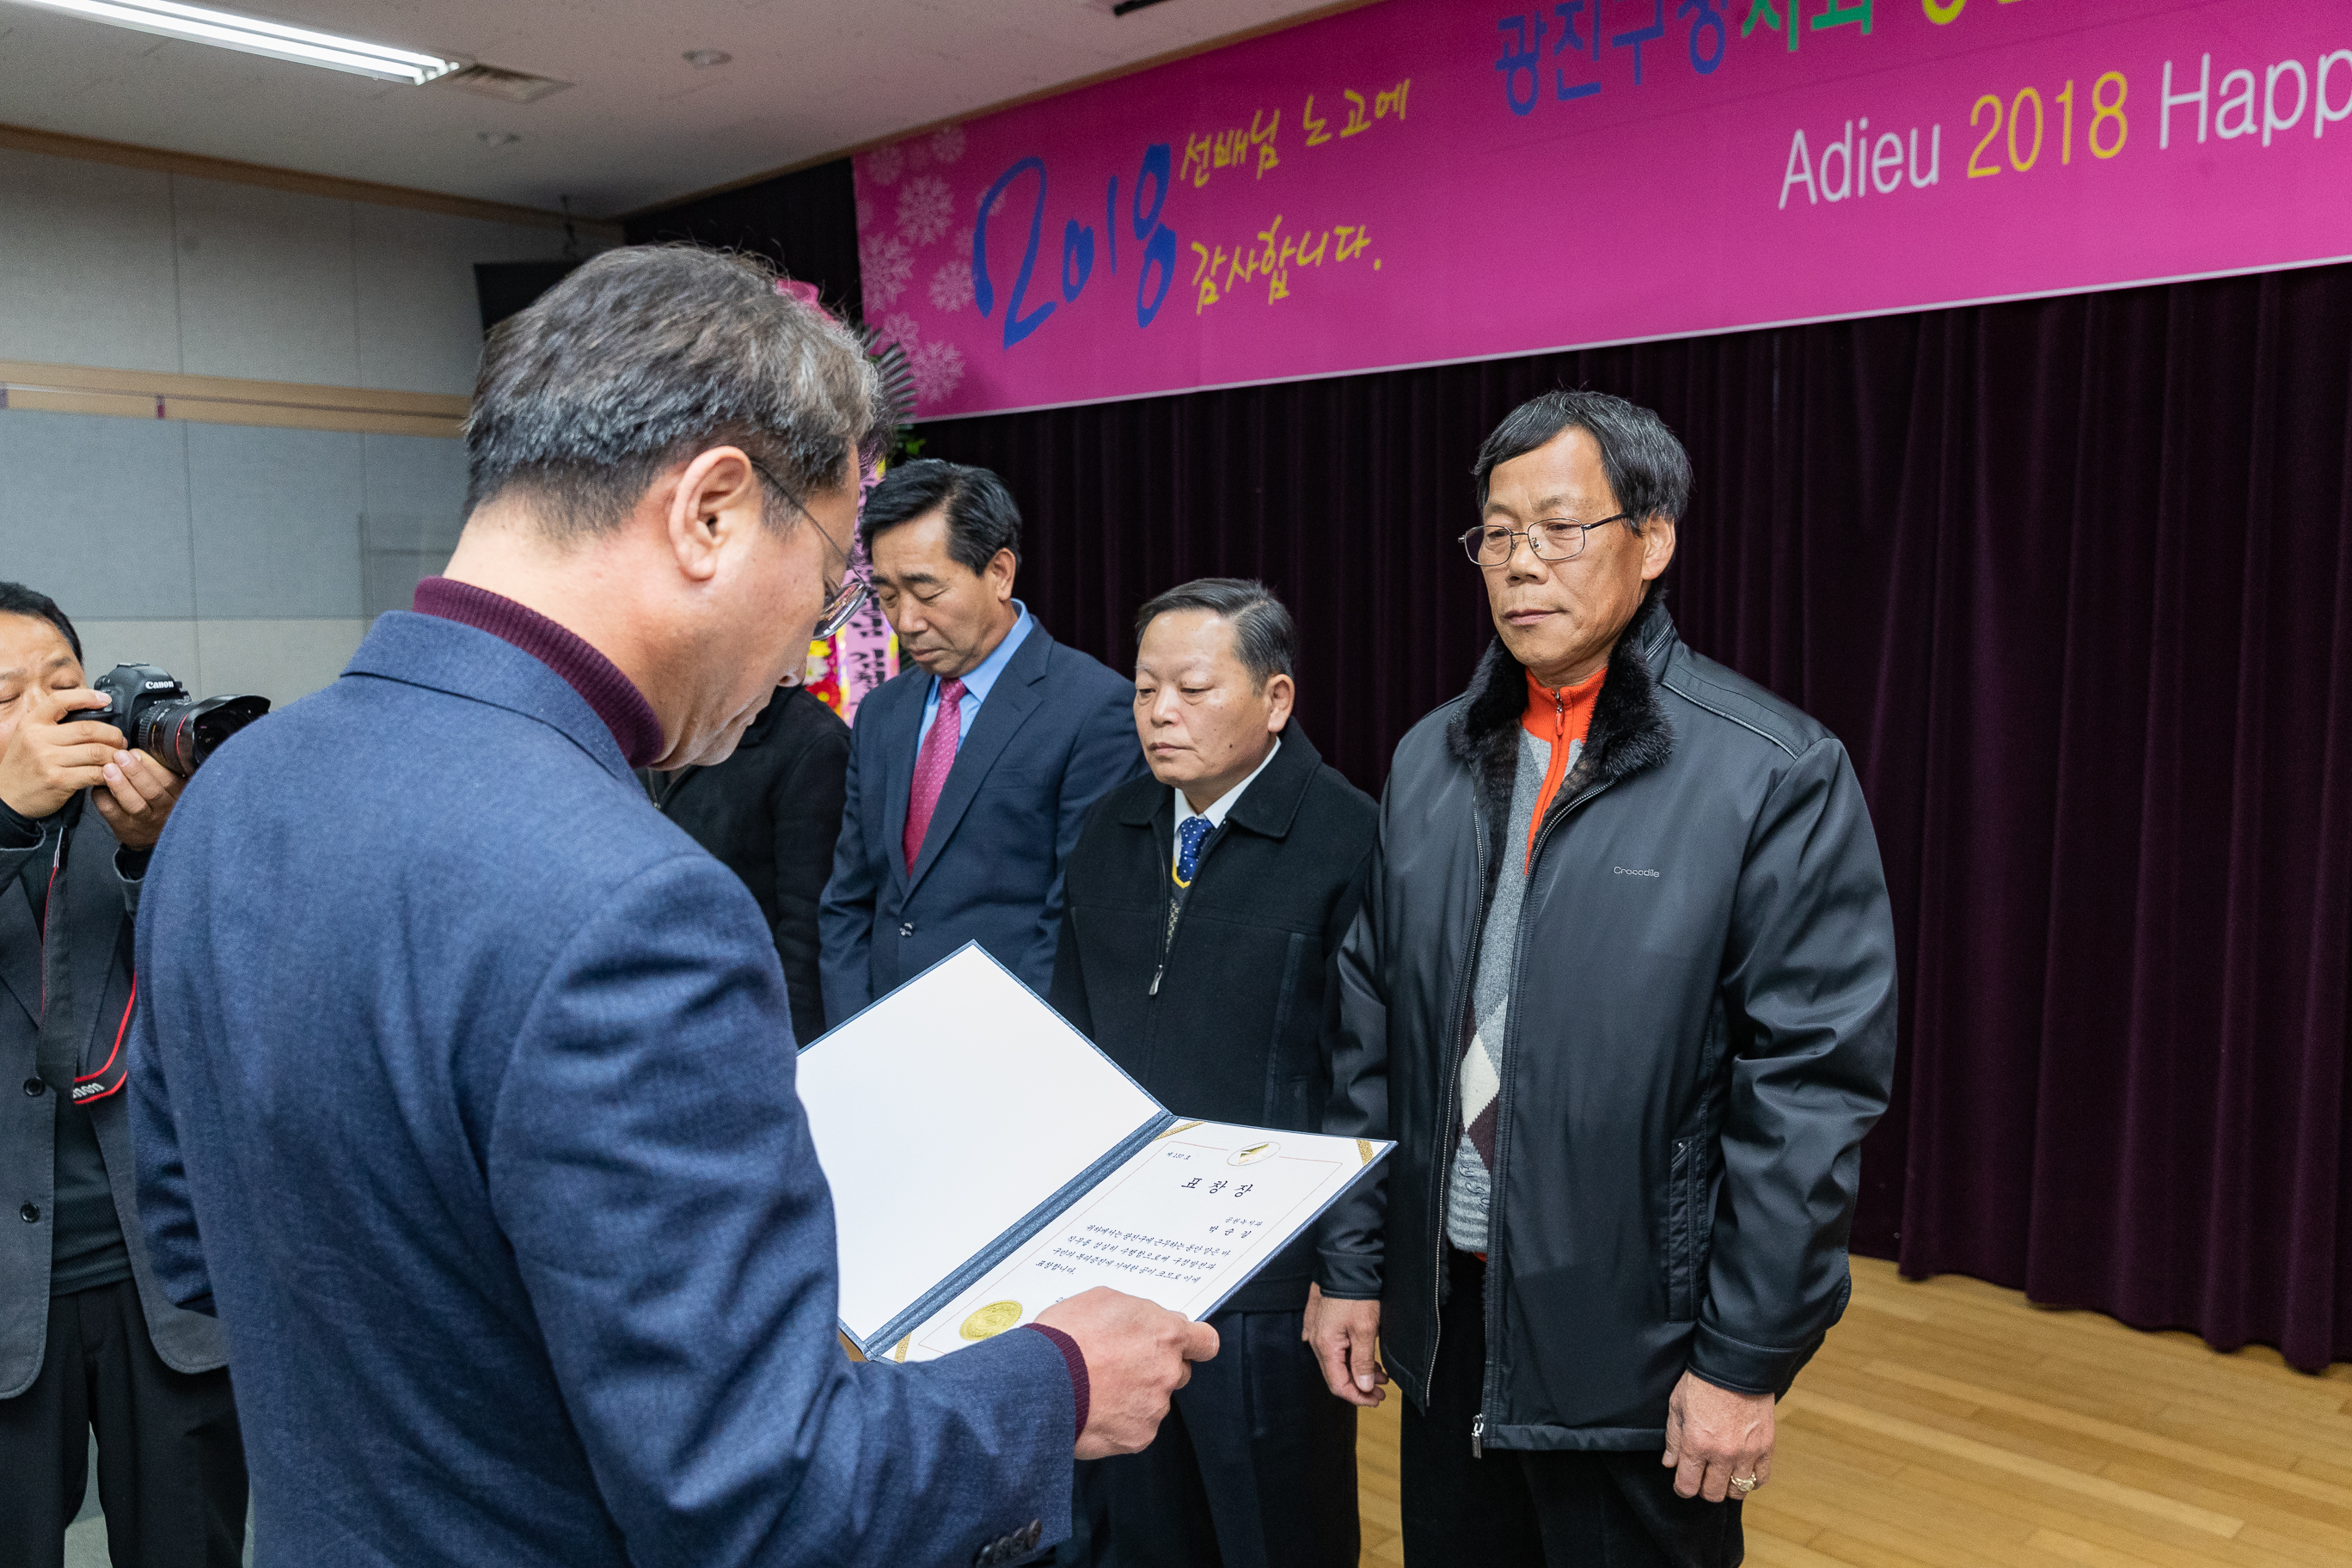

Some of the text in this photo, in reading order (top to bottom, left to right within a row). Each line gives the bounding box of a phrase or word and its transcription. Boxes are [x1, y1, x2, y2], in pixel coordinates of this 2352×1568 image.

[1179, 108, 1280, 187] 선배님
[1778, 117, 1940, 209] Adieu
[1968, 70, 2128, 178] 2018
[972, 143, 1177, 351] 2018
[1191, 215, 1381, 315] 감사합니다.
[145, 680, 175, 689] Canon
[1613, 866, 1660, 878] Crocodile
[1093, 1241, 1119, 1253] 성실히
